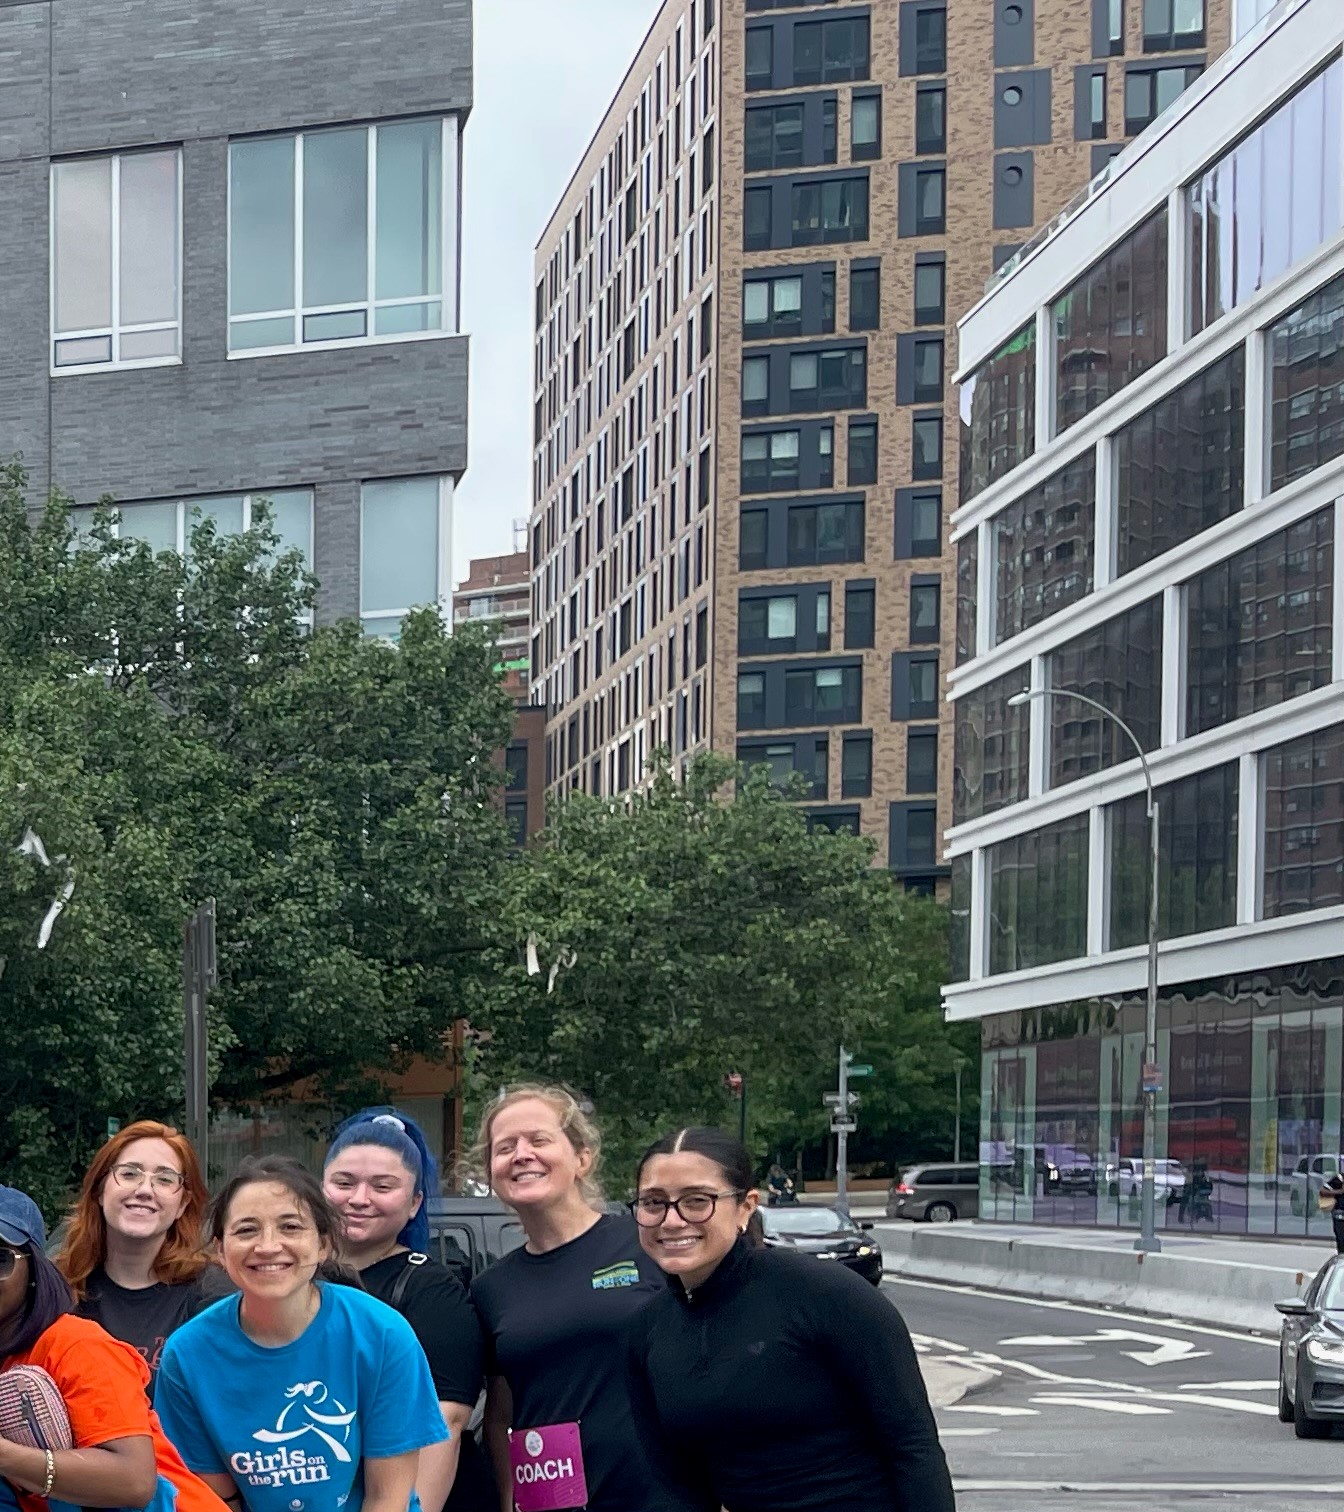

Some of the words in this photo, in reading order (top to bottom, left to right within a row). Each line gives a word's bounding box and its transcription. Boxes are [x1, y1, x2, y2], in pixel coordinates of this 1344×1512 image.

[231, 1446, 307, 1474] Girls
[307, 1455, 326, 1465] on
[515, 1457, 574, 1485] COACH
[248, 1475, 272, 1486] the
[271, 1463, 331, 1488] run
